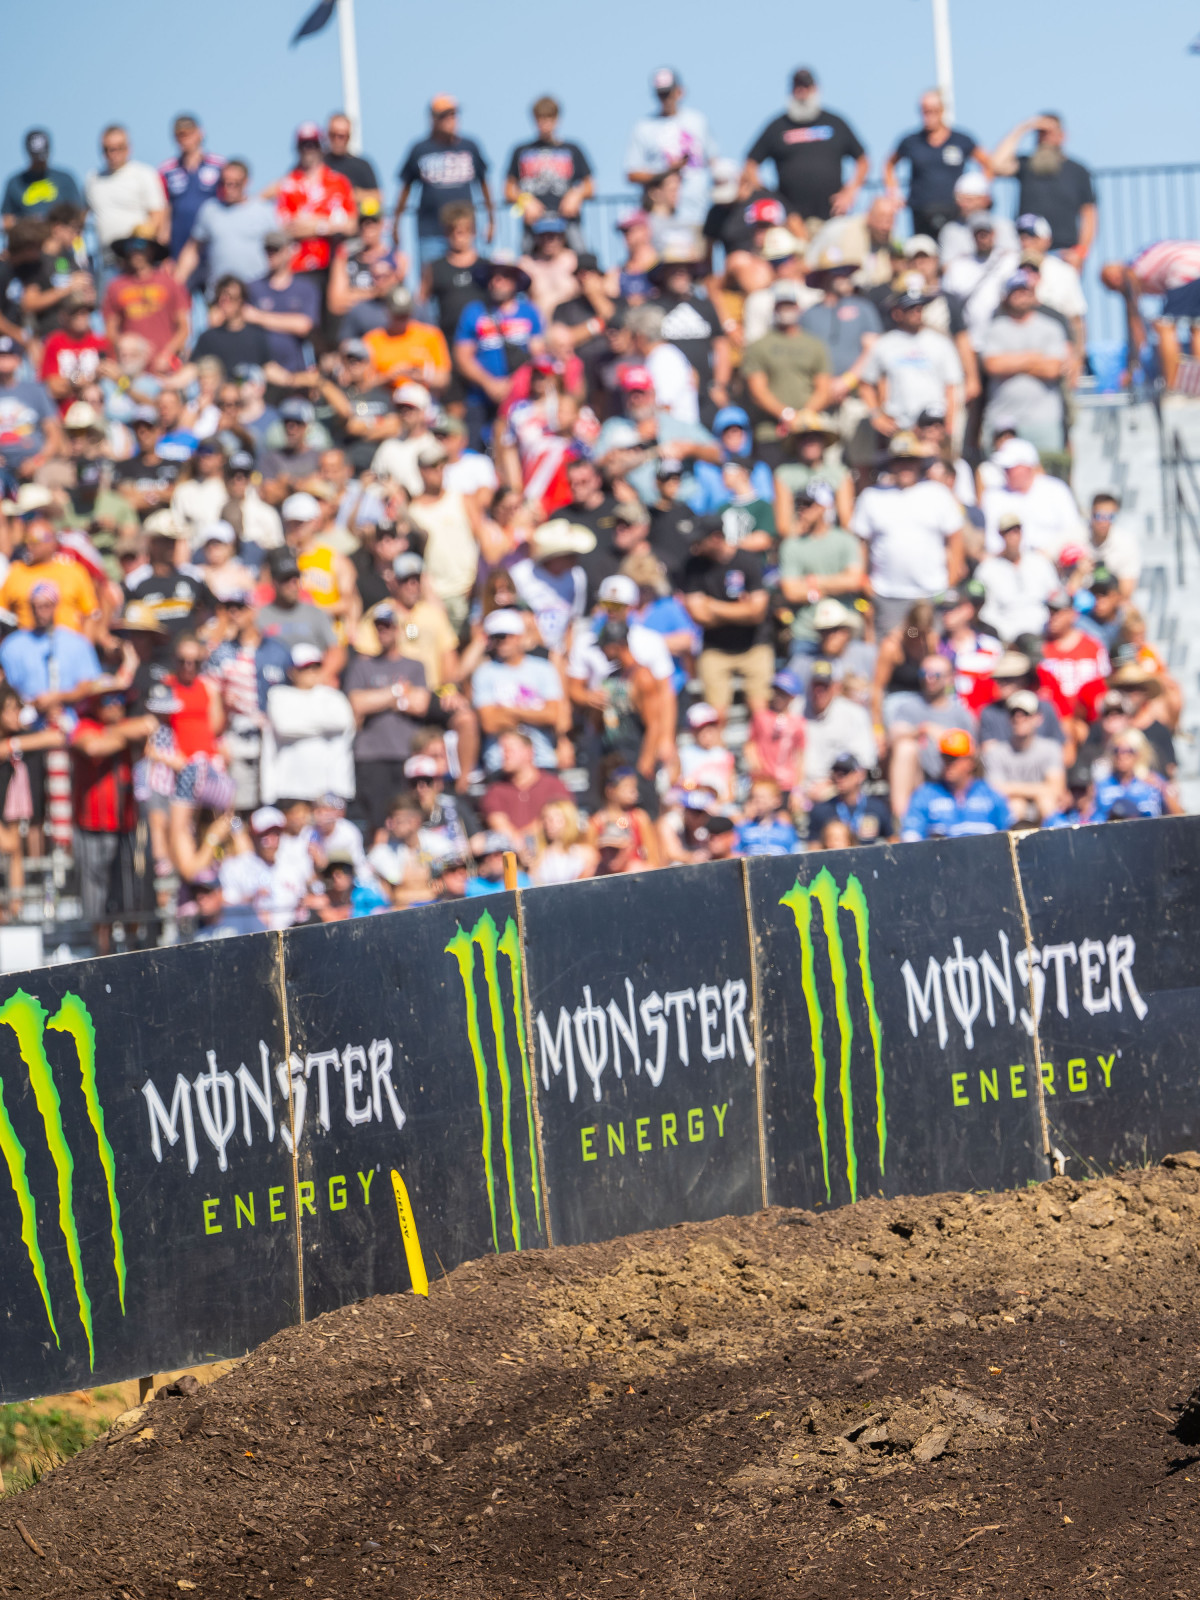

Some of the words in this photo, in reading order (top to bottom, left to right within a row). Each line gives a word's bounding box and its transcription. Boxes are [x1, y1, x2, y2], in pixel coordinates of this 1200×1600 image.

[901, 929, 1149, 1050] MONSTER
[534, 976, 758, 1104] MONSTER
[951, 1053, 1117, 1108] ENERGY
[140, 1038, 407, 1174] MONSTER
[580, 1102, 731, 1162] ENERGY
[203, 1168, 376, 1236] ENERGY
